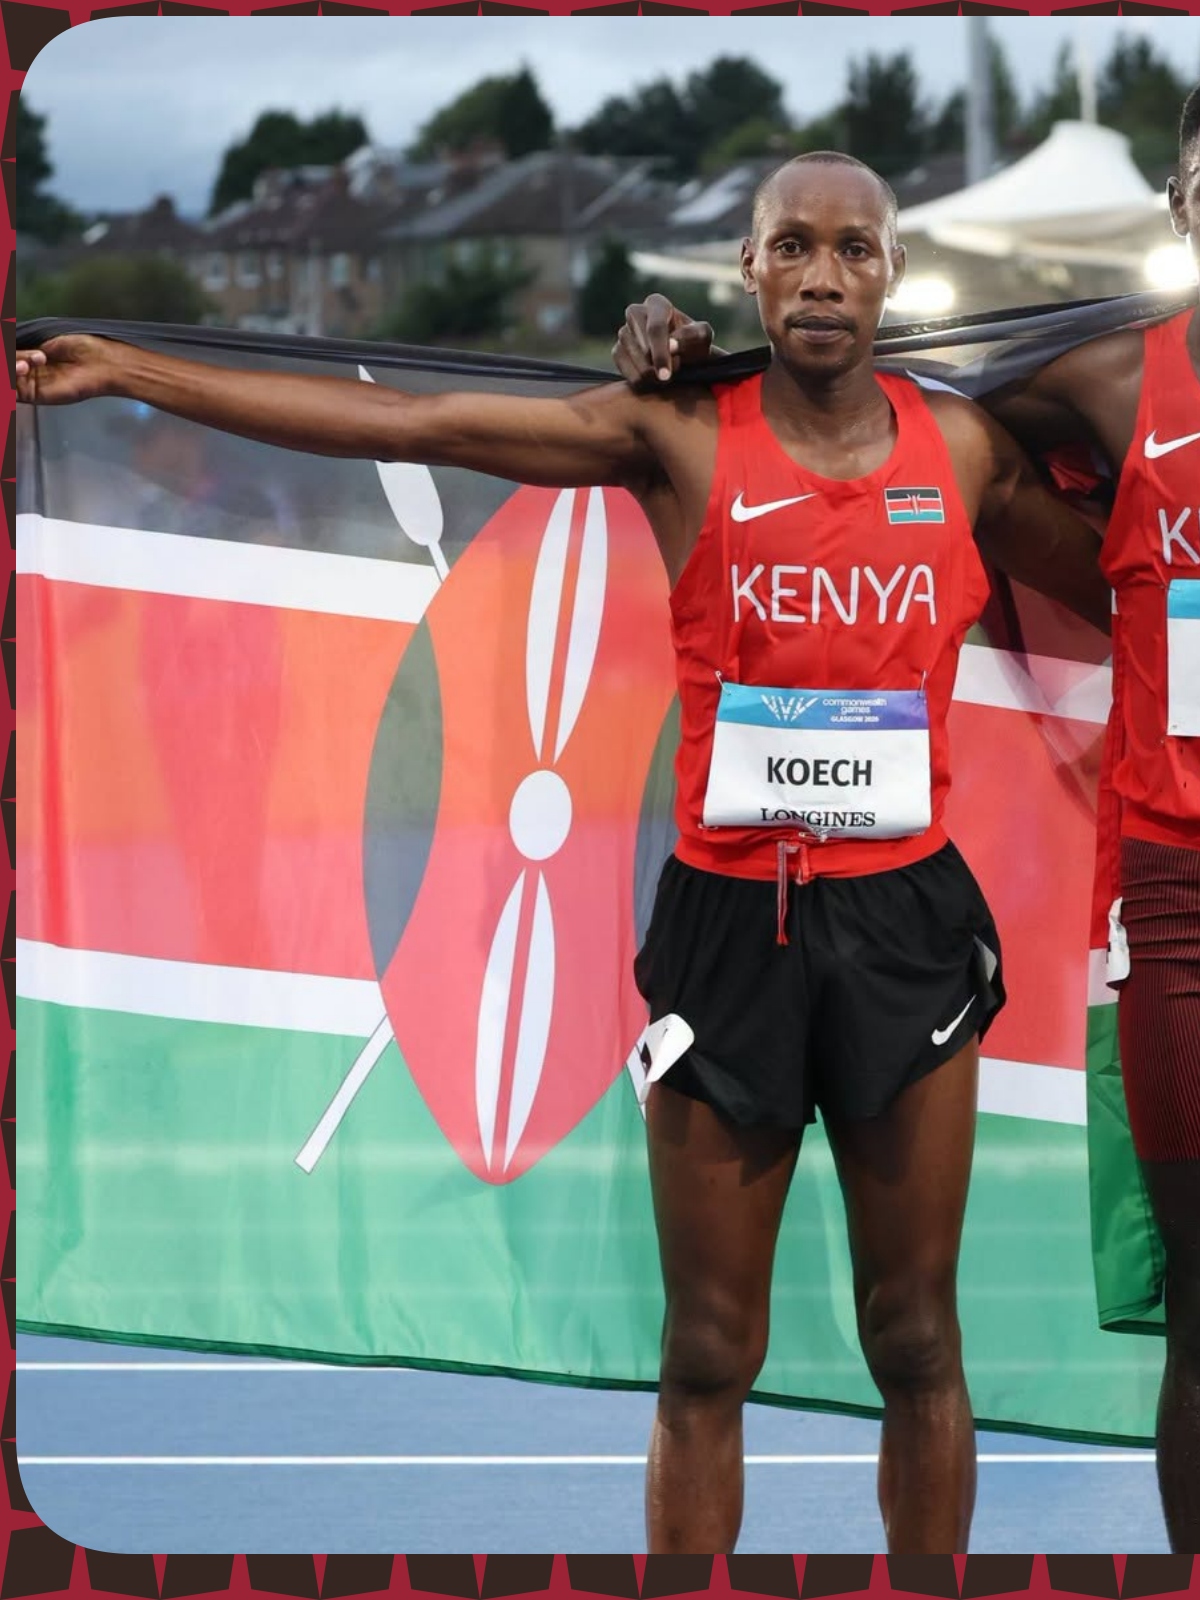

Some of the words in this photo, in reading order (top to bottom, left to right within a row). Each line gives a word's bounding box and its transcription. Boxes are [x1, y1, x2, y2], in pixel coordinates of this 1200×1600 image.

[731, 564, 937, 625] KENYA
[822, 697, 888, 707] commonwealth
[841, 706, 871, 714] games
[767, 756, 873, 787] KOECH
[760, 807, 877, 828] LONGINES
